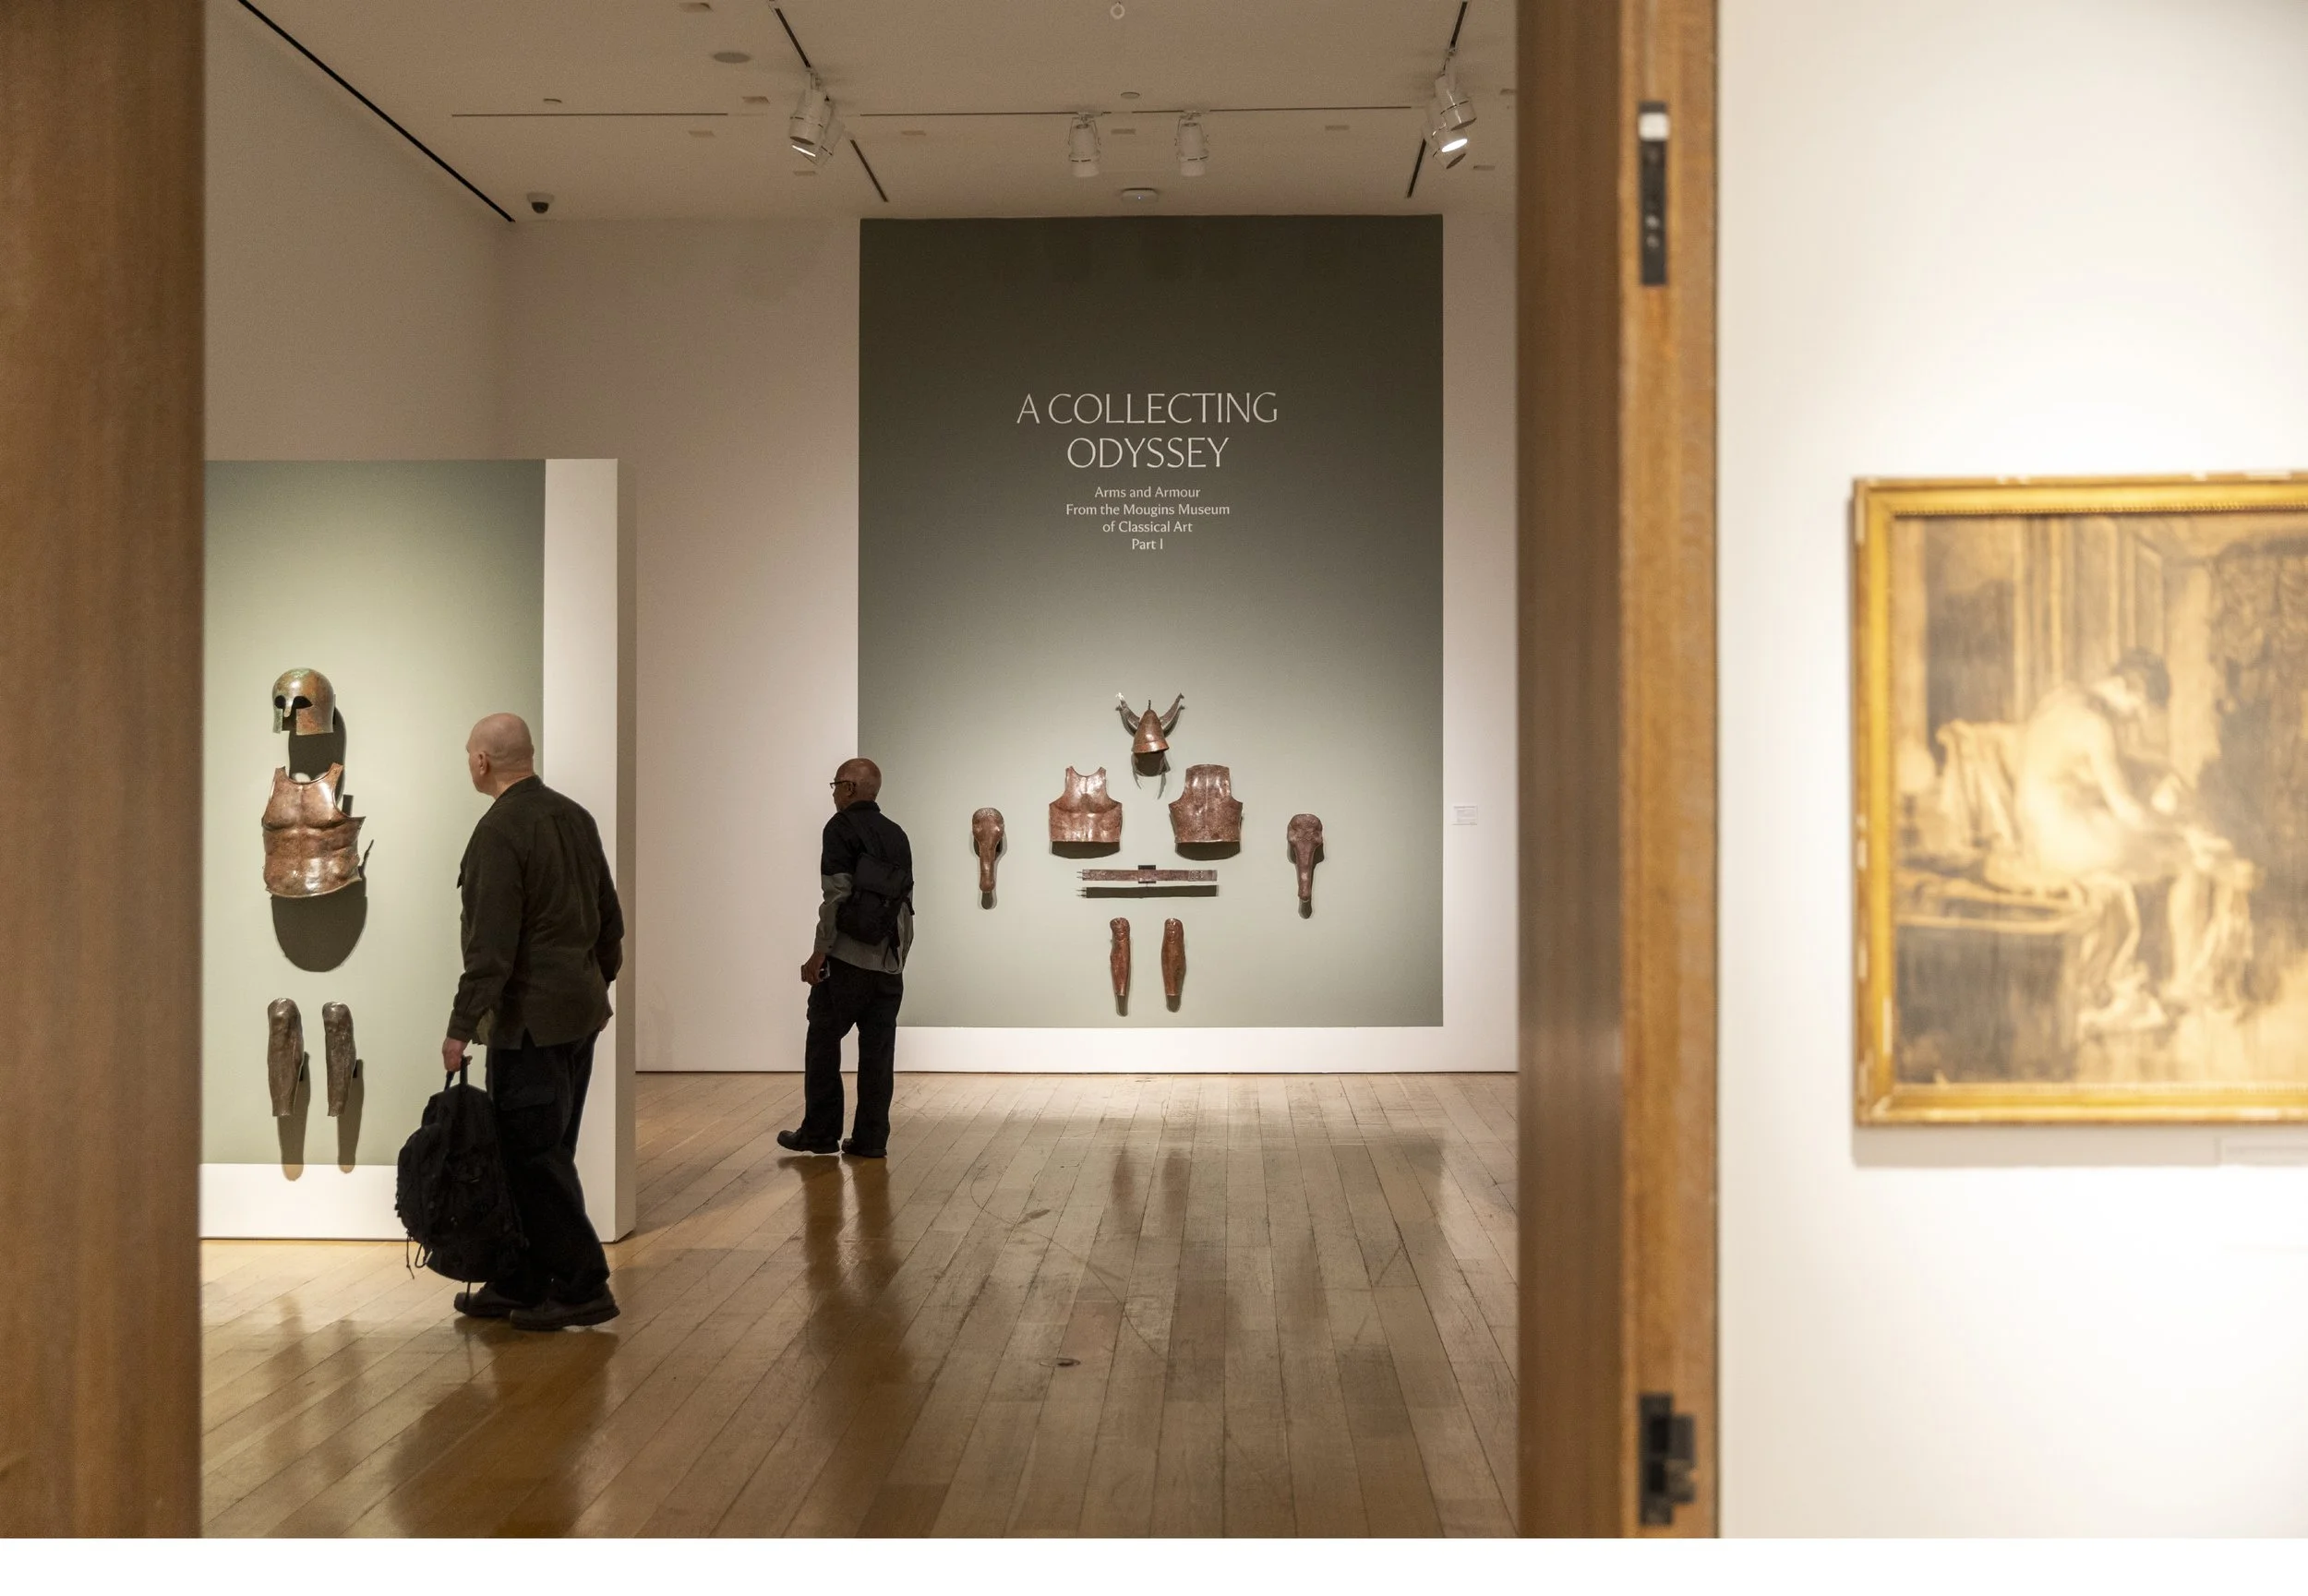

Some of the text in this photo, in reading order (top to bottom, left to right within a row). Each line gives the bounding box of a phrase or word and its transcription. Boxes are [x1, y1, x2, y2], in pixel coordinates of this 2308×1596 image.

[1016, 391, 1279, 425] A COLLECTING
[1066, 437, 1230, 469] ODYSSEY
[1094, 486, 1201, 498] Arms and Armour
[1065, 503, 1231, 518] From the Mougins Museum
[1102, 521, 1194, 534] of Classical Art
[1131, 538, 1164, 551] Part I
